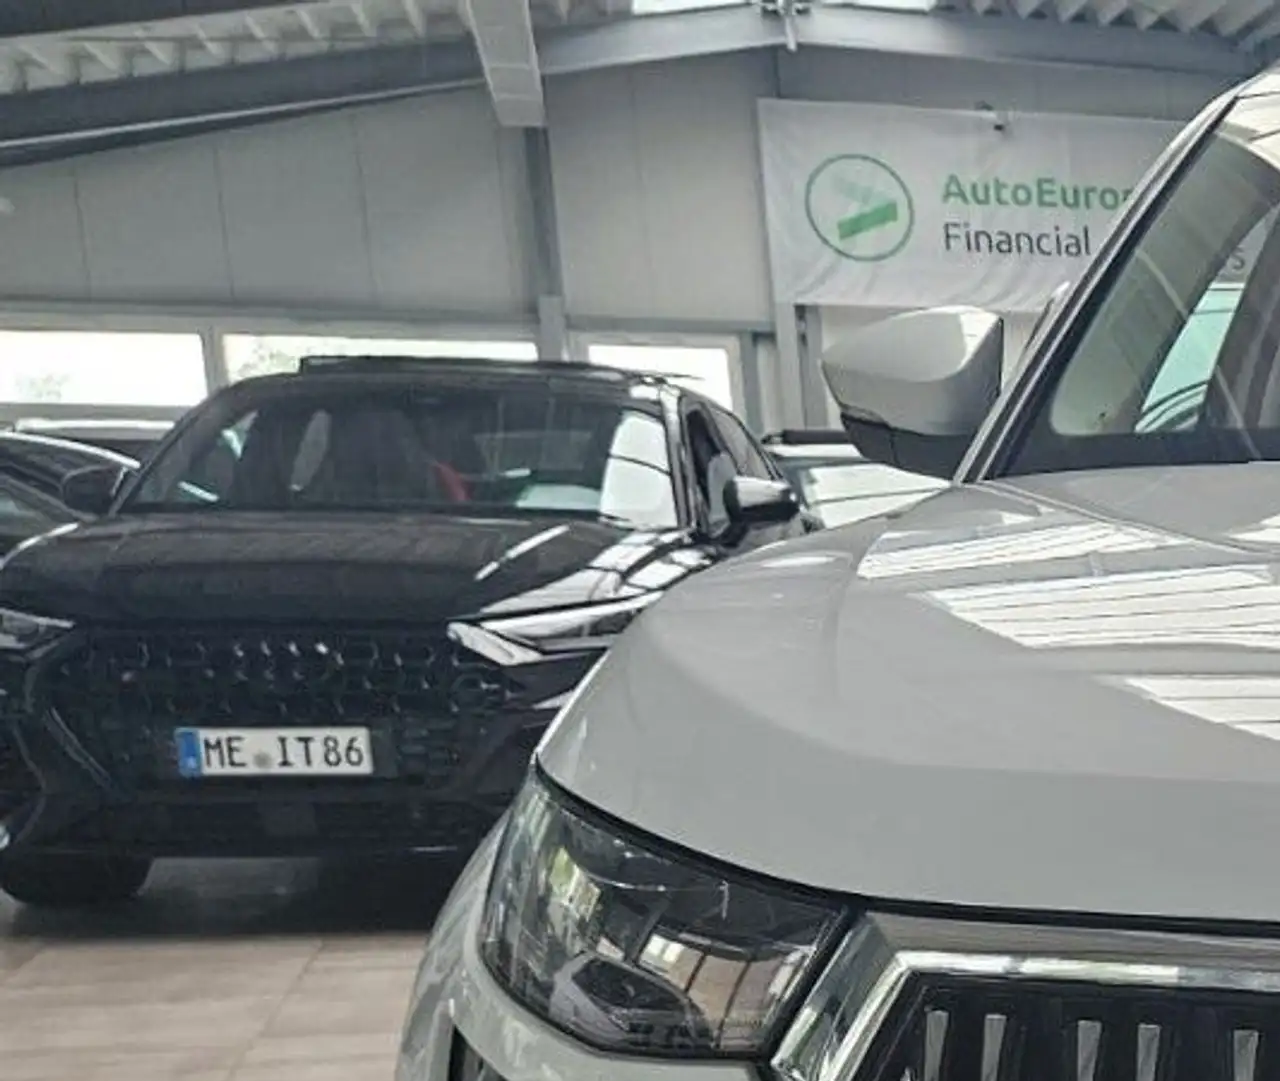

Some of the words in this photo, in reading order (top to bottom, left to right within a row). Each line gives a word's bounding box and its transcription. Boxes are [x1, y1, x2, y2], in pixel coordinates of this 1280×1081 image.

[943, 222, 1092, 258] Financial
[203, 735, 247, 768] ME
[277, 735, 364, 767] IT86
